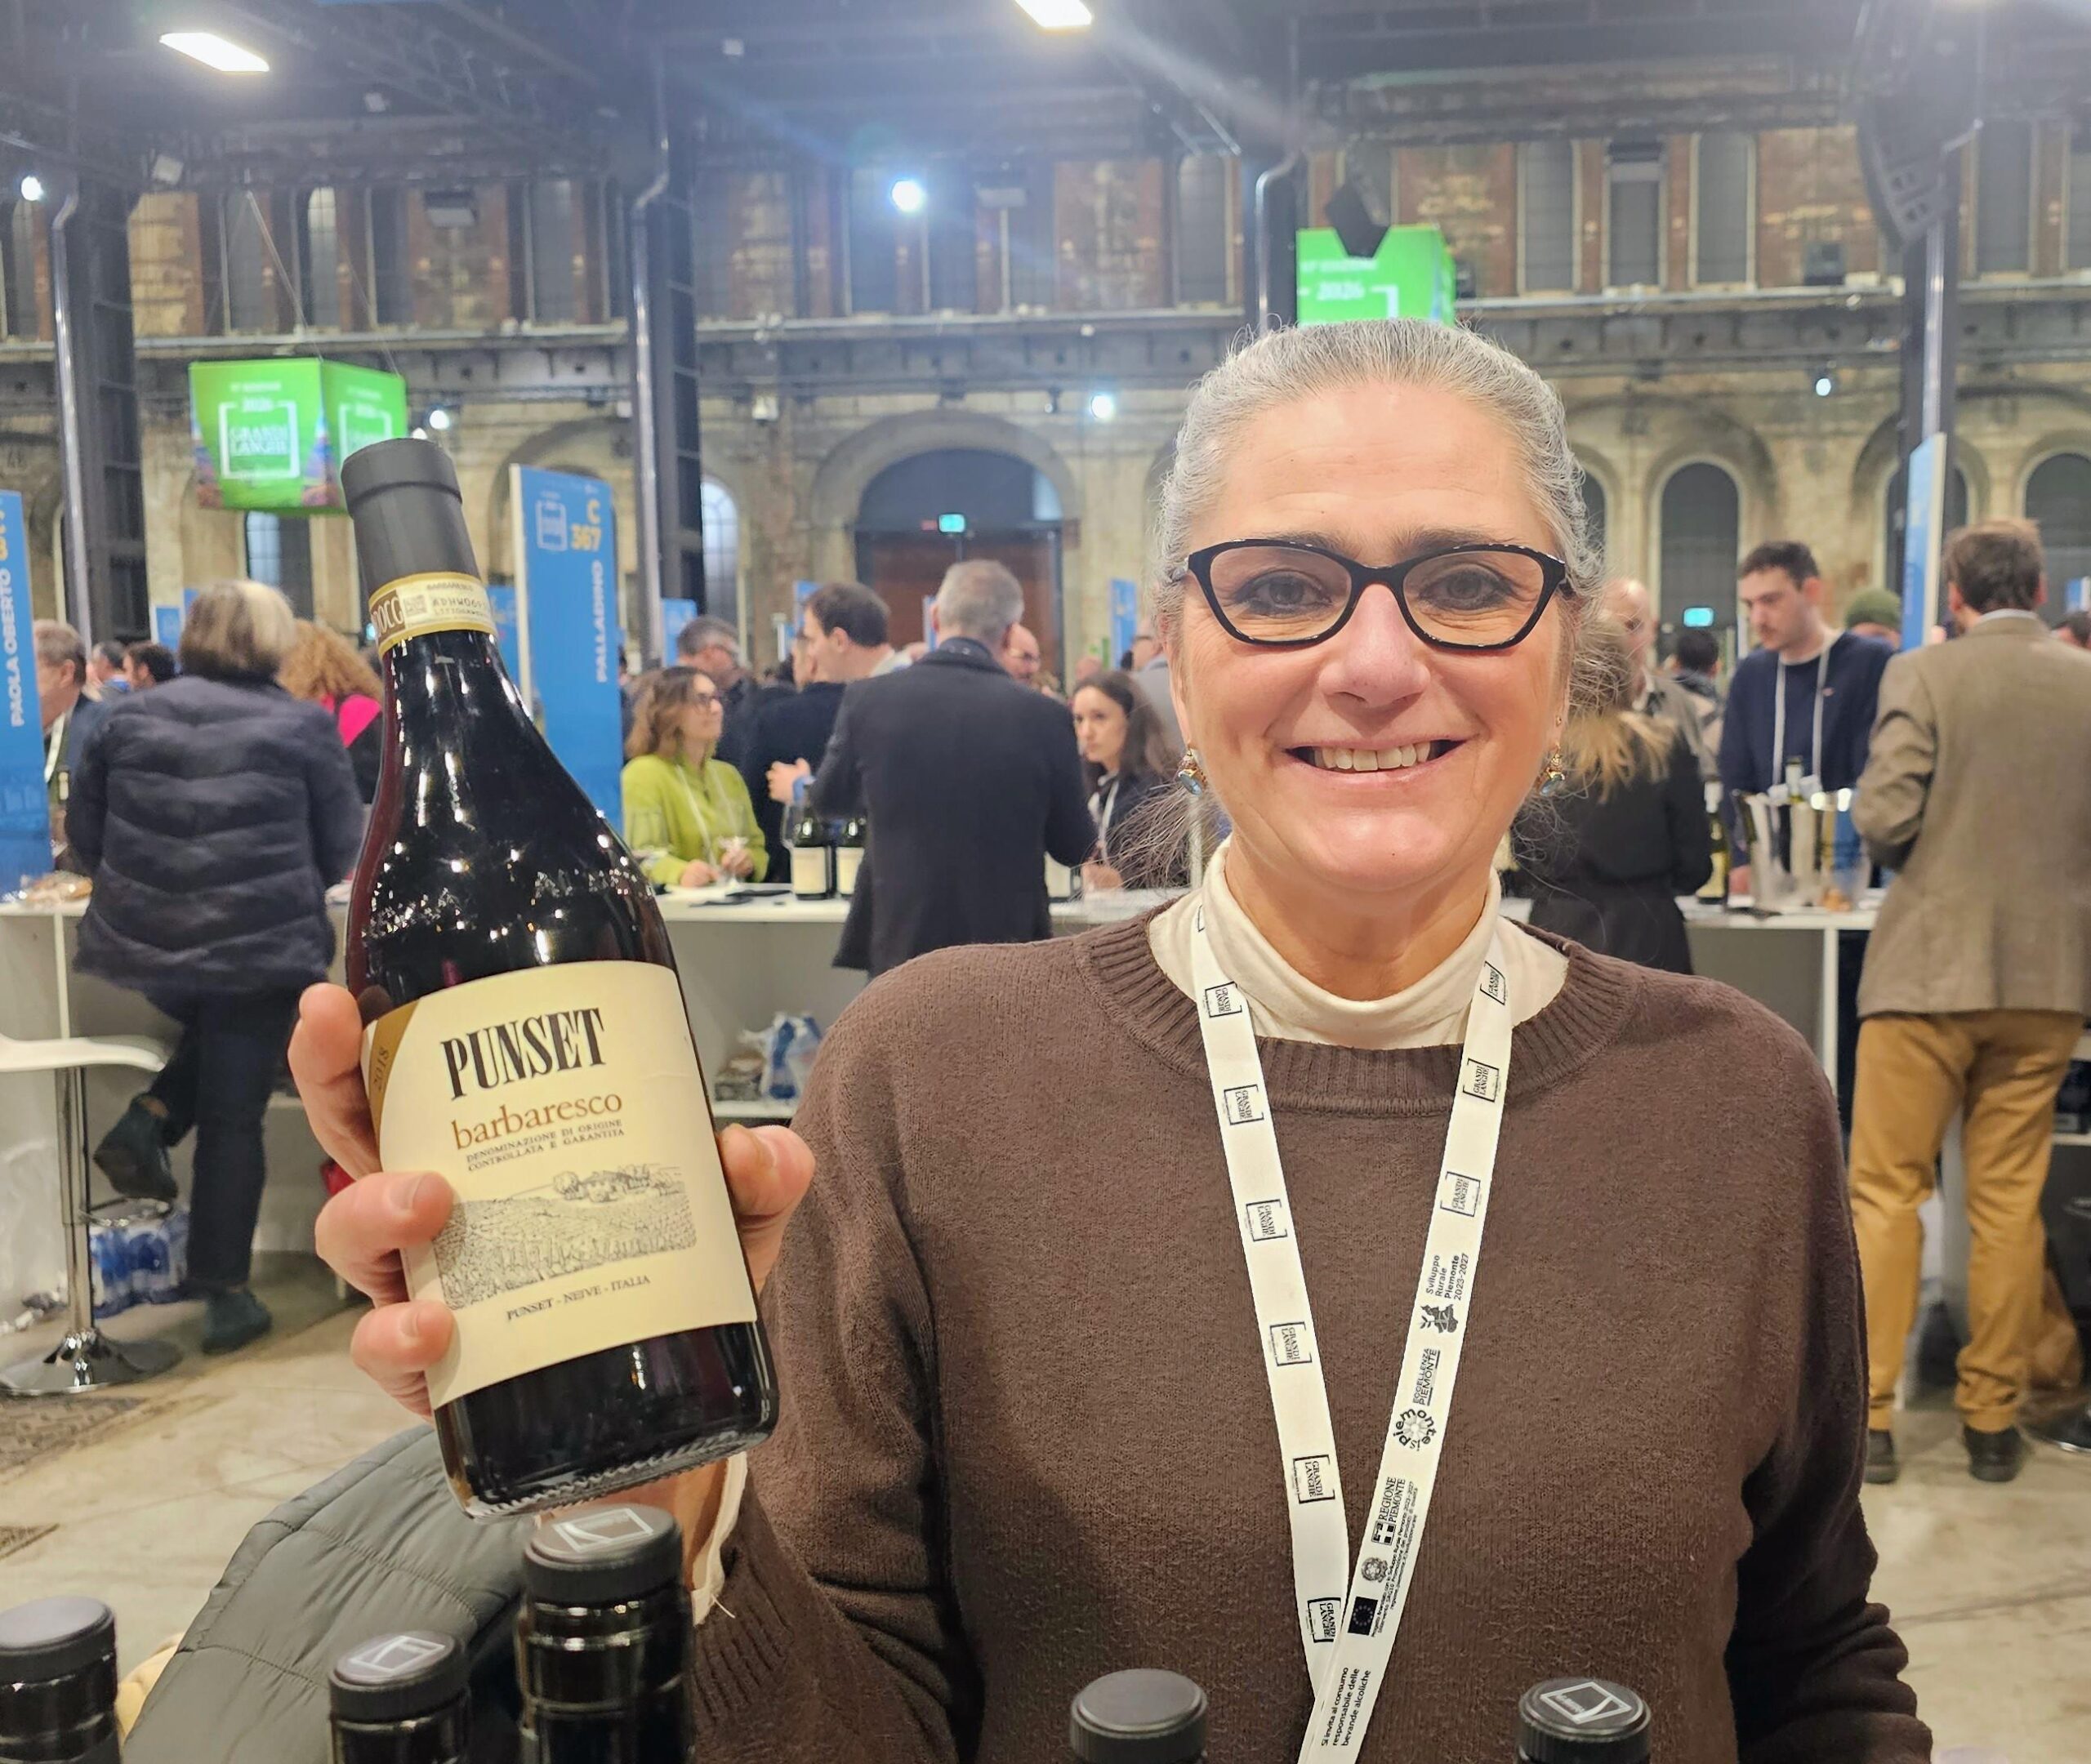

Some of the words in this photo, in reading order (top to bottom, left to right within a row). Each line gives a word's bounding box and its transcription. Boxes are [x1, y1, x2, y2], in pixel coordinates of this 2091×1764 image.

[591, 559, 608, 682] PALLADINO
[7, 656, 25, 727] PAOLA
[1215, 989, 1225, 1013] LANGHE
[1221, 987, 1232, 1013] GRANDI
[440, 1008, 606, 1101] PUNSET
[1474, 1066, 1483, 1094] GRANDI
[1479, 1067, 1489, 1096] LANGHE
[451, 1094, 622, 1150] barbaresco
[1235, 1091, 1246, 1120] LANGHE
[1242, 1089, 1253, 1119] GRANDI
[466, 1131, 556, 1163] DENOMINAZIONE
[561, 1128, 573, 1137] DI
[578, 1119, 622, 1133] ORIGINE
[468, 1144, 544, 1172] CONTROLLATA
[564, 1129, 625, 1145] GARANTITA
[1451, 1178, 1464, 1209] GRANDI
[1458, 1179, 1469, 1210] LANGHE
[1257, 1205, 1269, 1236] LANGHE
[1265, 1205, 1276, 1236] GRANDI
[1426, 1255, 1440, 1294] Sviluppo
[1435, 1267, 1447, 1297] Rurale
[1444, 1255, 1460, 1298] Piemonte
[1454, 1253, 1469, 1300] 2023-2027
[506, 1297, 555, 1321] PUNSET
[563, 1285, 602, 1303] NEIVE
[611, 1275, 650, 1291] ITALIA
[1282, 1328, 1294, 1361] LANGHE
[1289, 1327, 1300, 1360] GRANDI
[1413, 1348, 1429, 1403] ECCELLENZA
[1419, 1349, 1438, 1405] PIEMONTE
[1304, 1462, 1317, 1498] LANGHE
[1313, 1461, 1323, 1495] GRANDI
[1379, 1477, 1396, 1521] REGIONE
[1389, 1478, 1406, 1522] PIEMONTE
[1319, 1603, 1330, 1637] LANGHE
[1326, 1602, 1335, 1637] GRANDI
[1324, 1716, 1335, 1737] invita
[1335, 1667, 1349, 1705] consumo
[1333, 1691, 1353, 1746] responsabile
[1348, 1668, 1360, 1690] delle
[1340, 1709, 1358, 1746] bevande
[1354, 1670, 1371, 1708] alcoliche
